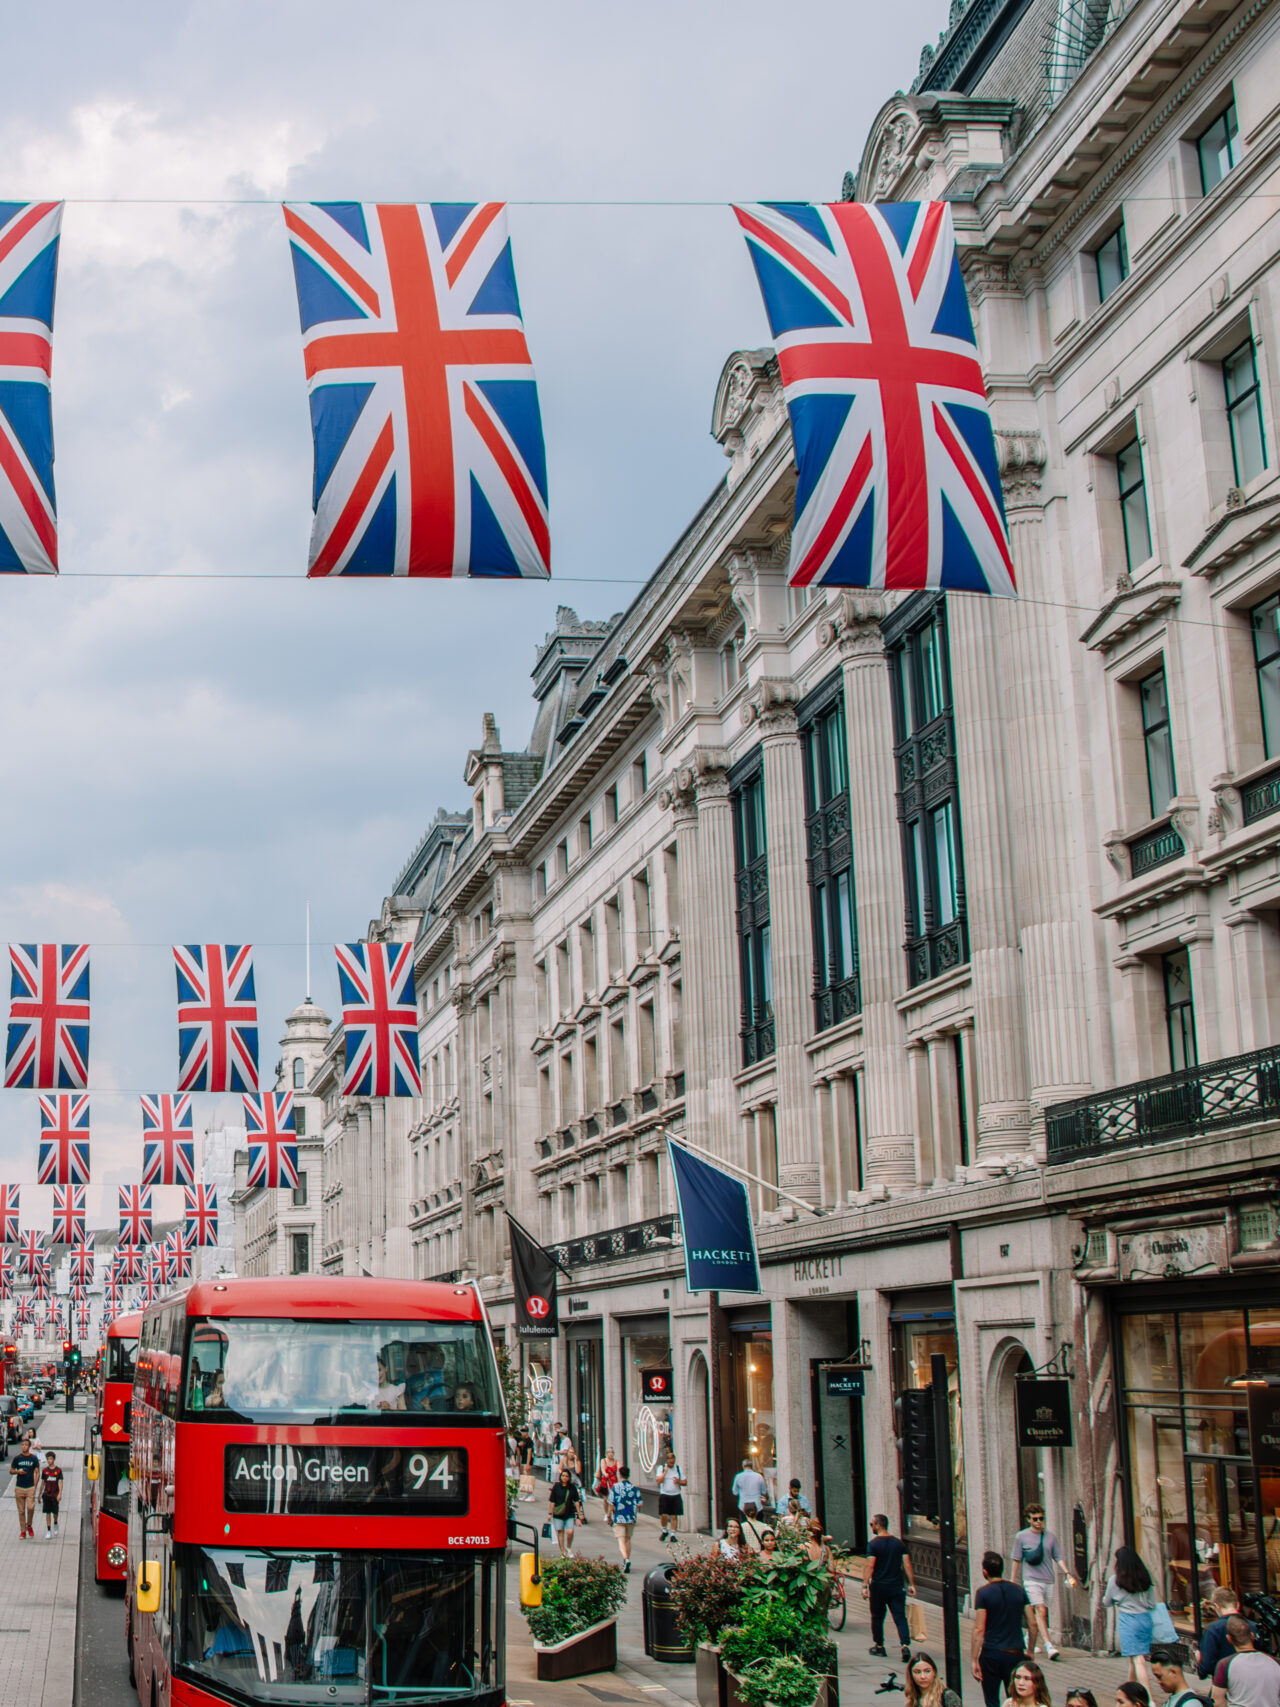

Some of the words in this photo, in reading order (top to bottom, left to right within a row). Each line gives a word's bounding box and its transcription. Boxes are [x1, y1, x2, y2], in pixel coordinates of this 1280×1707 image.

[692, 1250, 751, 1262] HACKETT
[1152, 1238, 1189, 1255] Church's
[793, 1257, 842, 1282] HACKETT
[235, 1457, 297, 1480] Acton
[305, 1459, 369, 1482] Green
[409, 1454, 454, 1490] 94
[465, 1536, 490, 1545] 47013
